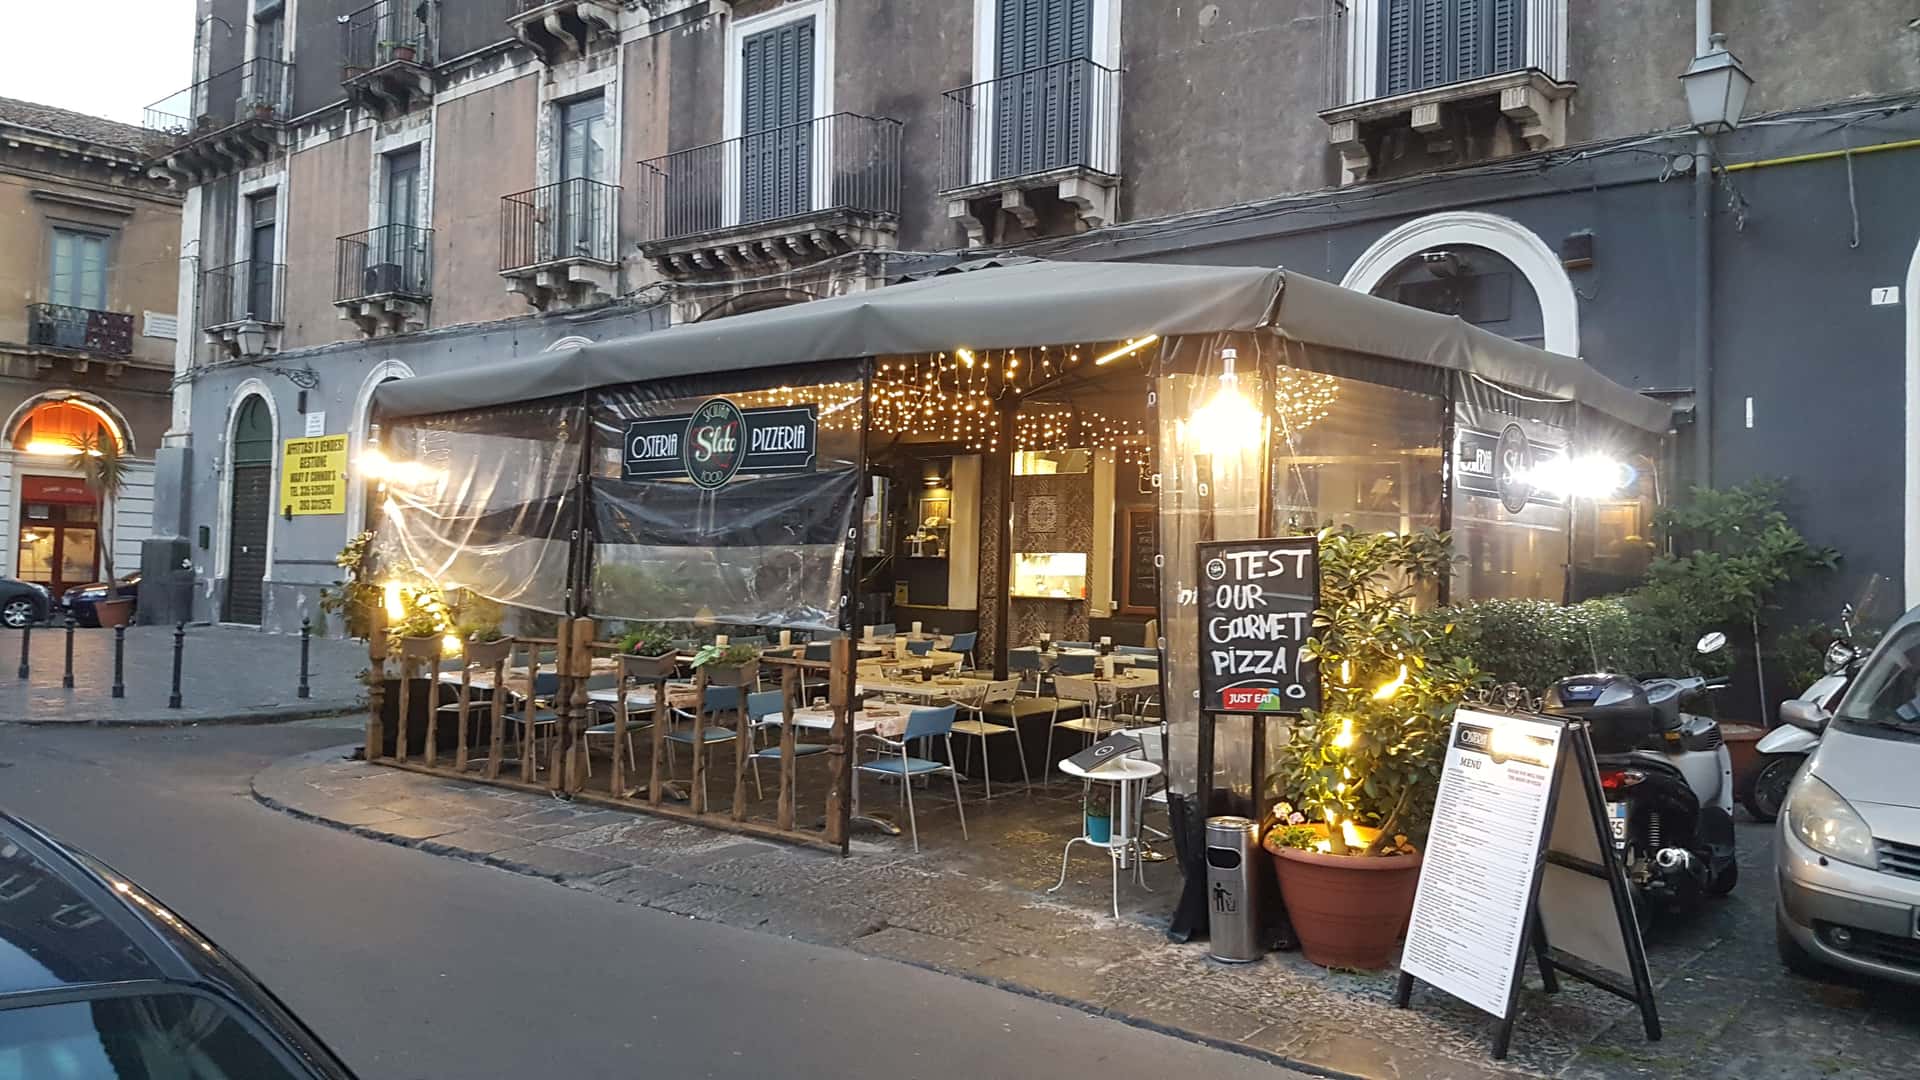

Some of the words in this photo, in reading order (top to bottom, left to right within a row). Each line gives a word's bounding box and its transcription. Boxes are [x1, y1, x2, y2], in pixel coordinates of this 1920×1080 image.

[1881, 289, 1889, 303] 7
[632, 433, 678, 458] OSTERIA
[752, 425, 805, 452] PIZZERIA
[1226, 549, 1312, 580] TEST
[1216, 584, 1267, 610] OUR
[1208, 612, 1307, 644] GOURMET
[1228, 693, 1252, 704] JUST
[1254, 693, 1273, 703] EAT
